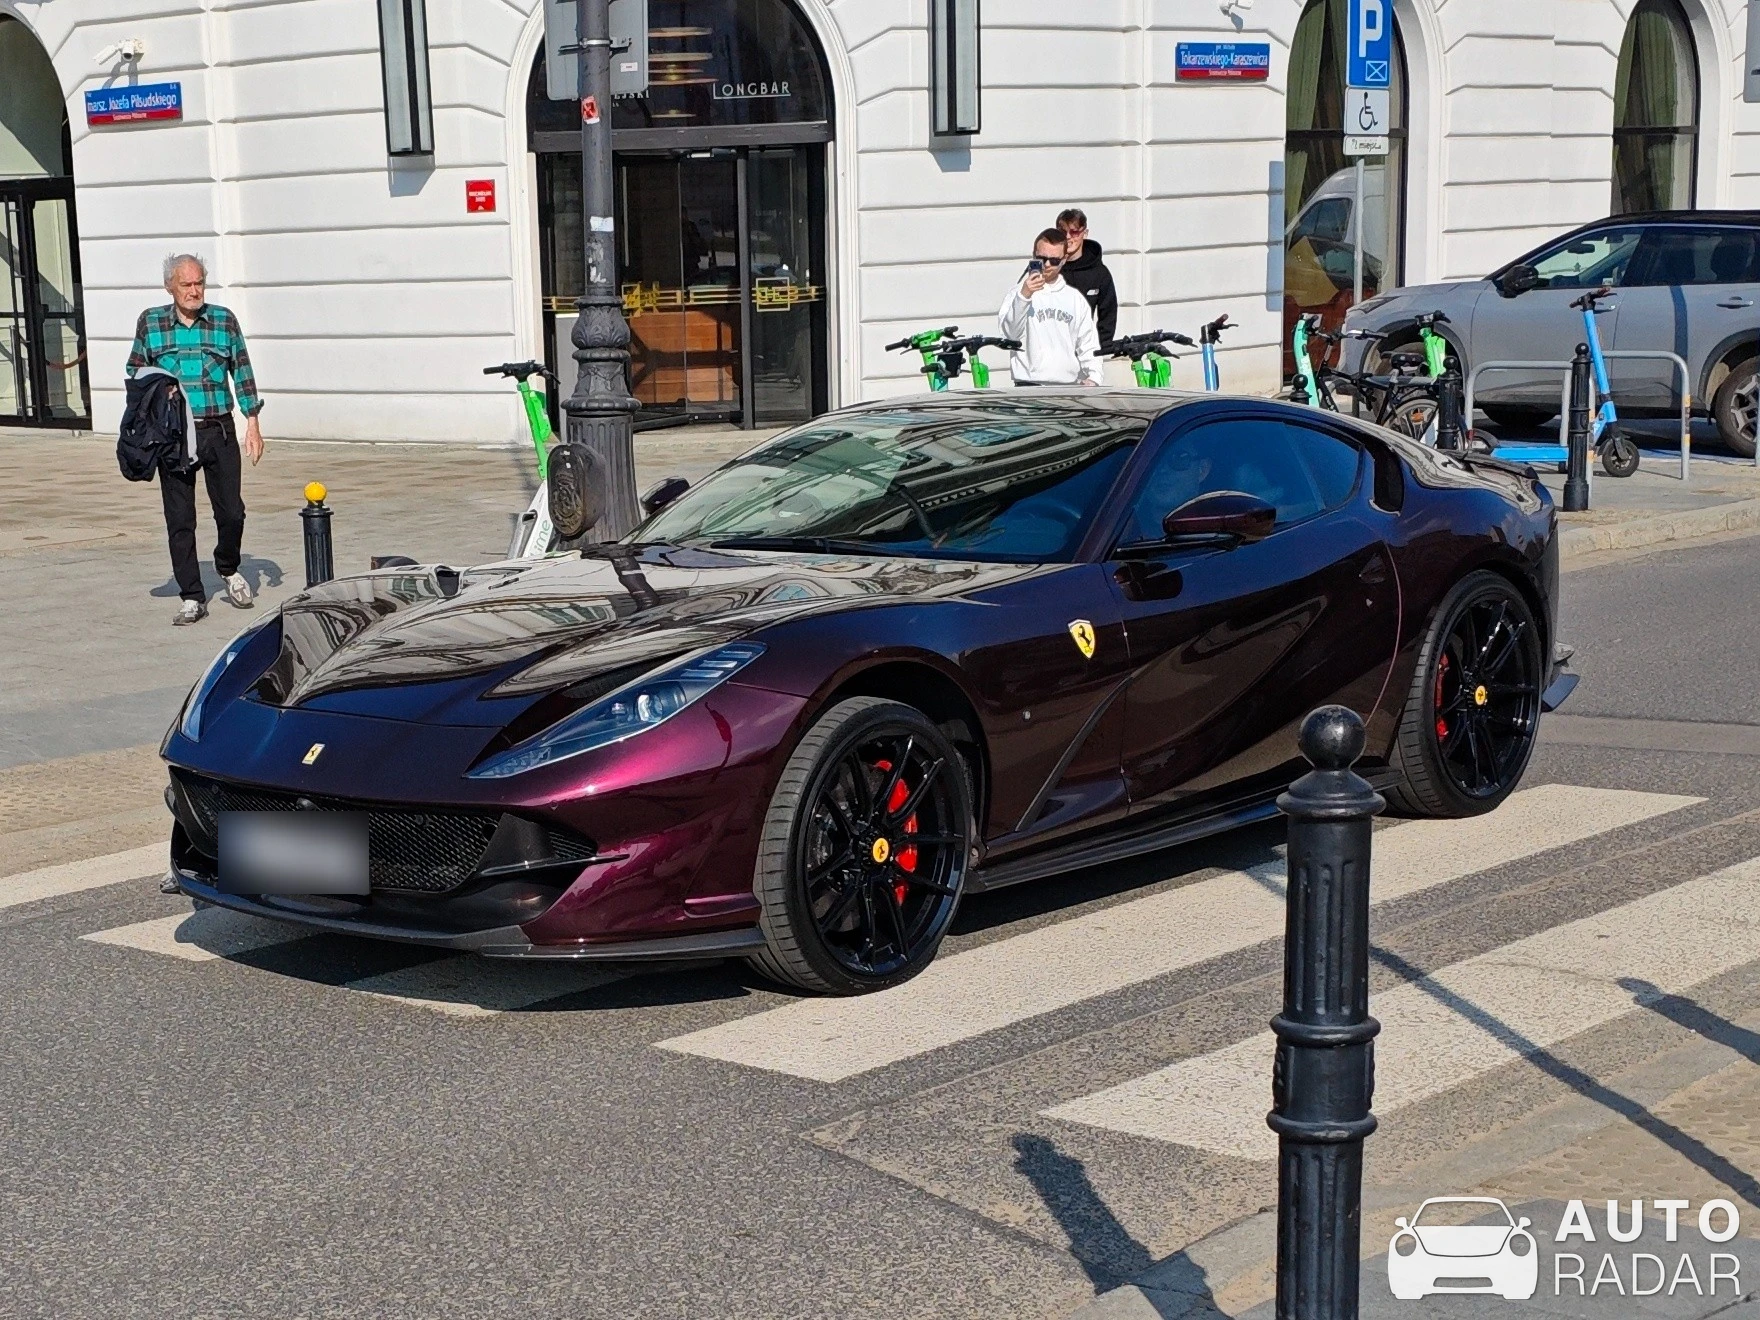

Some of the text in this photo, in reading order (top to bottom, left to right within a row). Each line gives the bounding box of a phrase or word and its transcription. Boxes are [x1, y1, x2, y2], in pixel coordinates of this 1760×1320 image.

[1358, 0, 1383, 58] P
[712, 81, 792, 99] LONGBAR
[108, 94, 130, 110] Józefa
